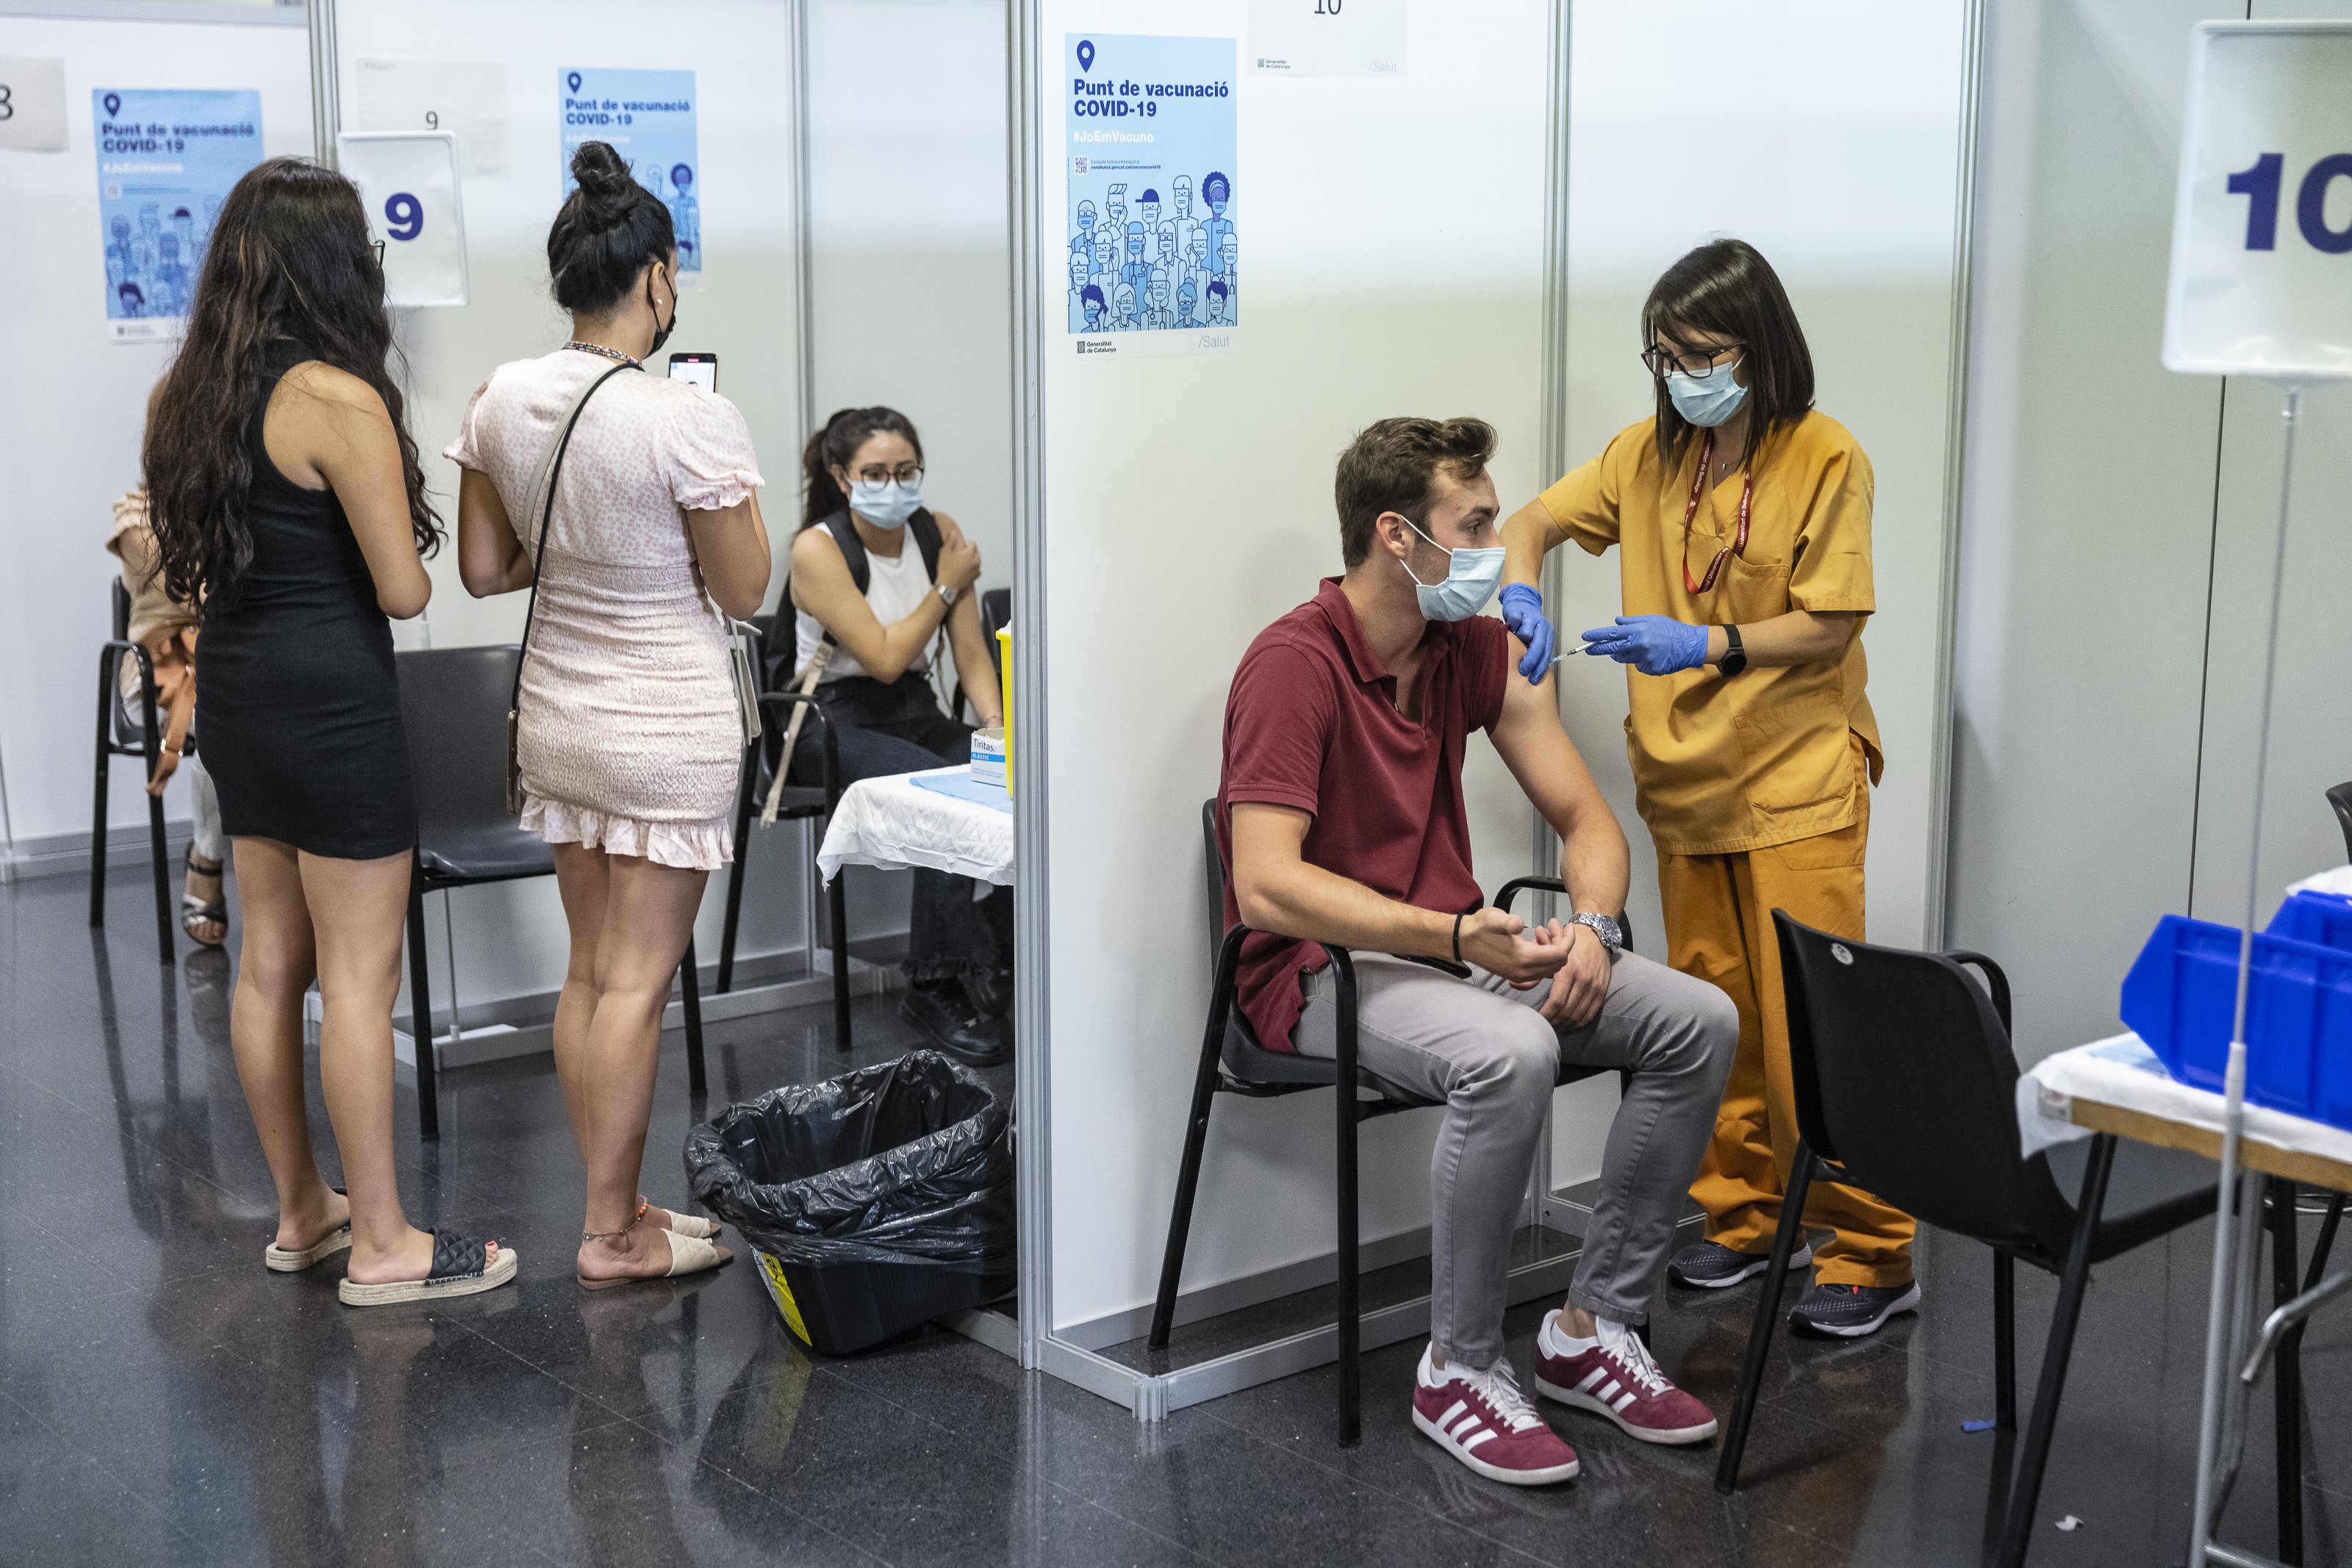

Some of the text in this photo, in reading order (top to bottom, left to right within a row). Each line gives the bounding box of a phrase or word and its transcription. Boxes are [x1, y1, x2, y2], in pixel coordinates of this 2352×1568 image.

[1074, 79, 1230, 97] Punt de vacunació
[565, 98, 691, 112] Punt de vacunació
[1074, 100, 1157, 117] COVID-19
[426, 110, 439, 131] 9
[566, 112, 633, 126] COVID-19
[101, 122, 255, 137] Punt de vacunació
[1072, 130, 1154, 143] #JoEmVacuno
[103, 137, 185, 154] COVID-19
[2226, 151, 2352, 255] 10
[384, 192, 424, 242] 9
[1198, 334, 1230, 349] /Salut
